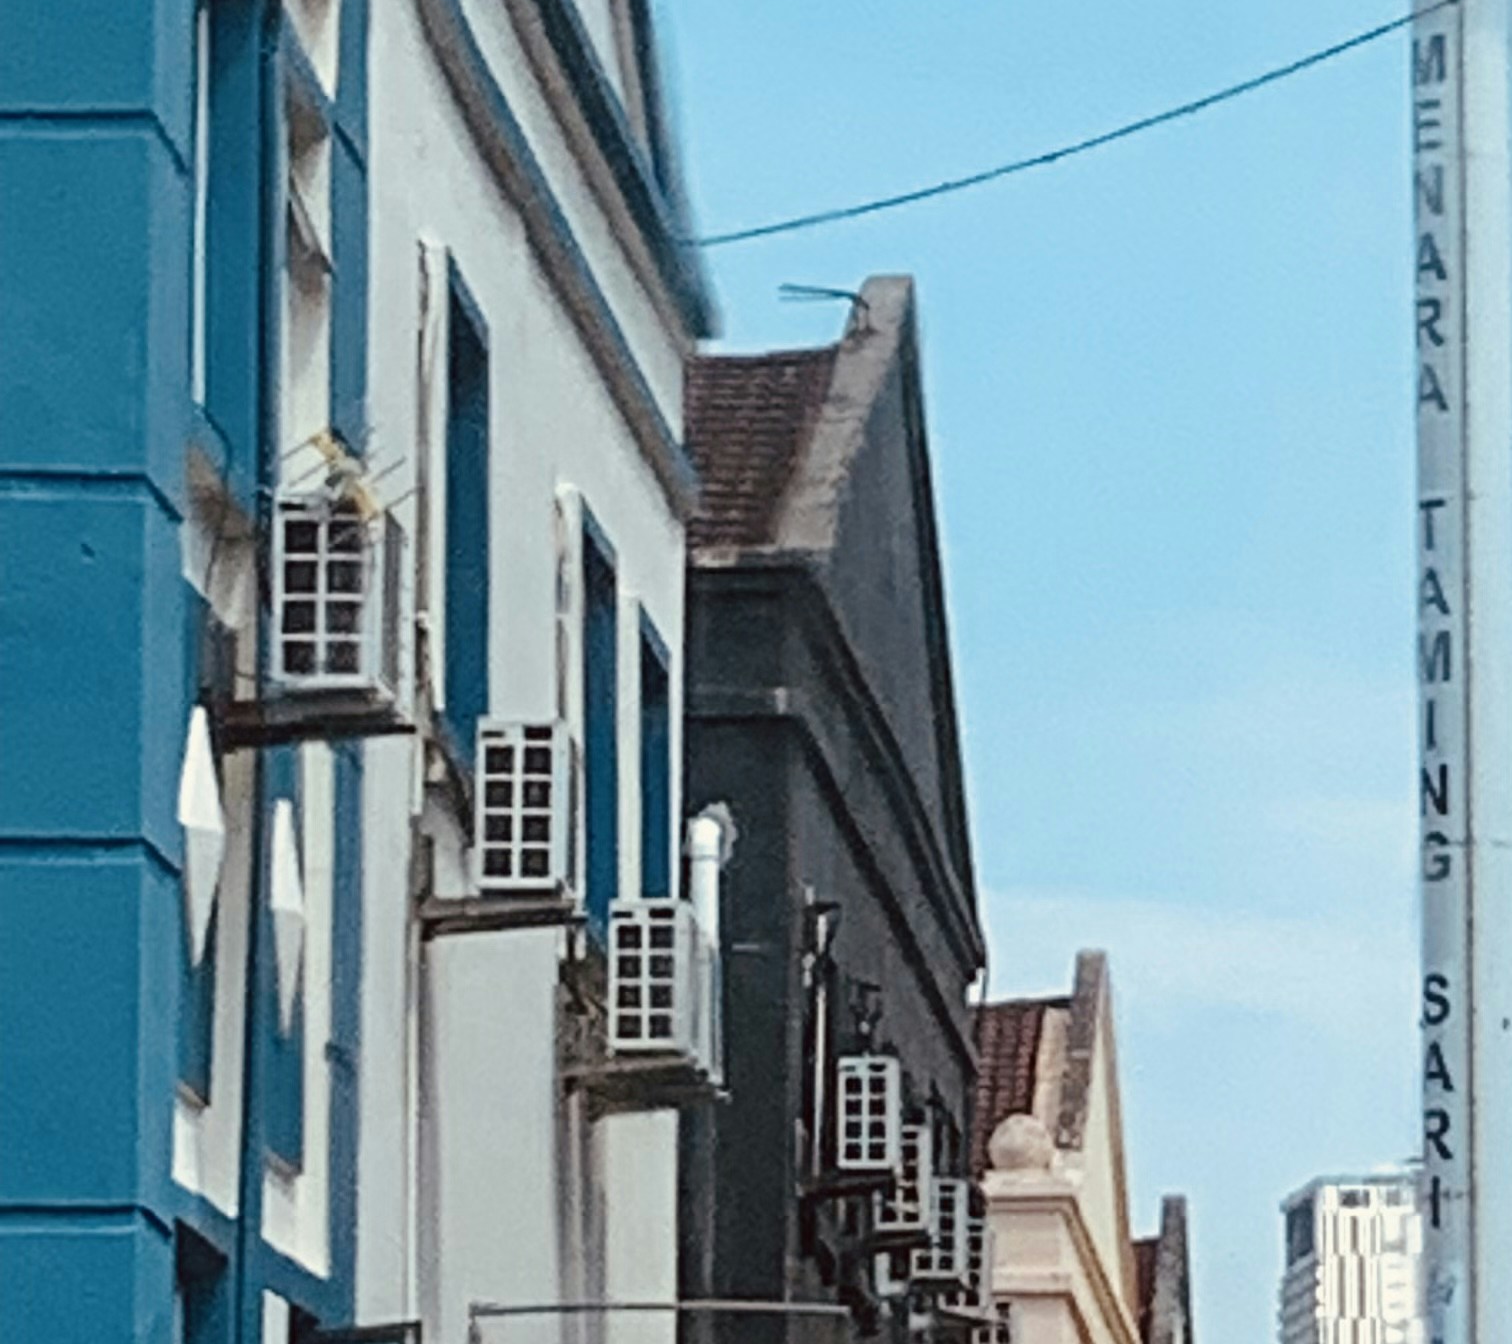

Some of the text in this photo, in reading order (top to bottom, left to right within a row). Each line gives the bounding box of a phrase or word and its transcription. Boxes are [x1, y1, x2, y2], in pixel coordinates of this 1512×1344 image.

[1412, 34, 1455, 1229] MENARA TAMING SARI
